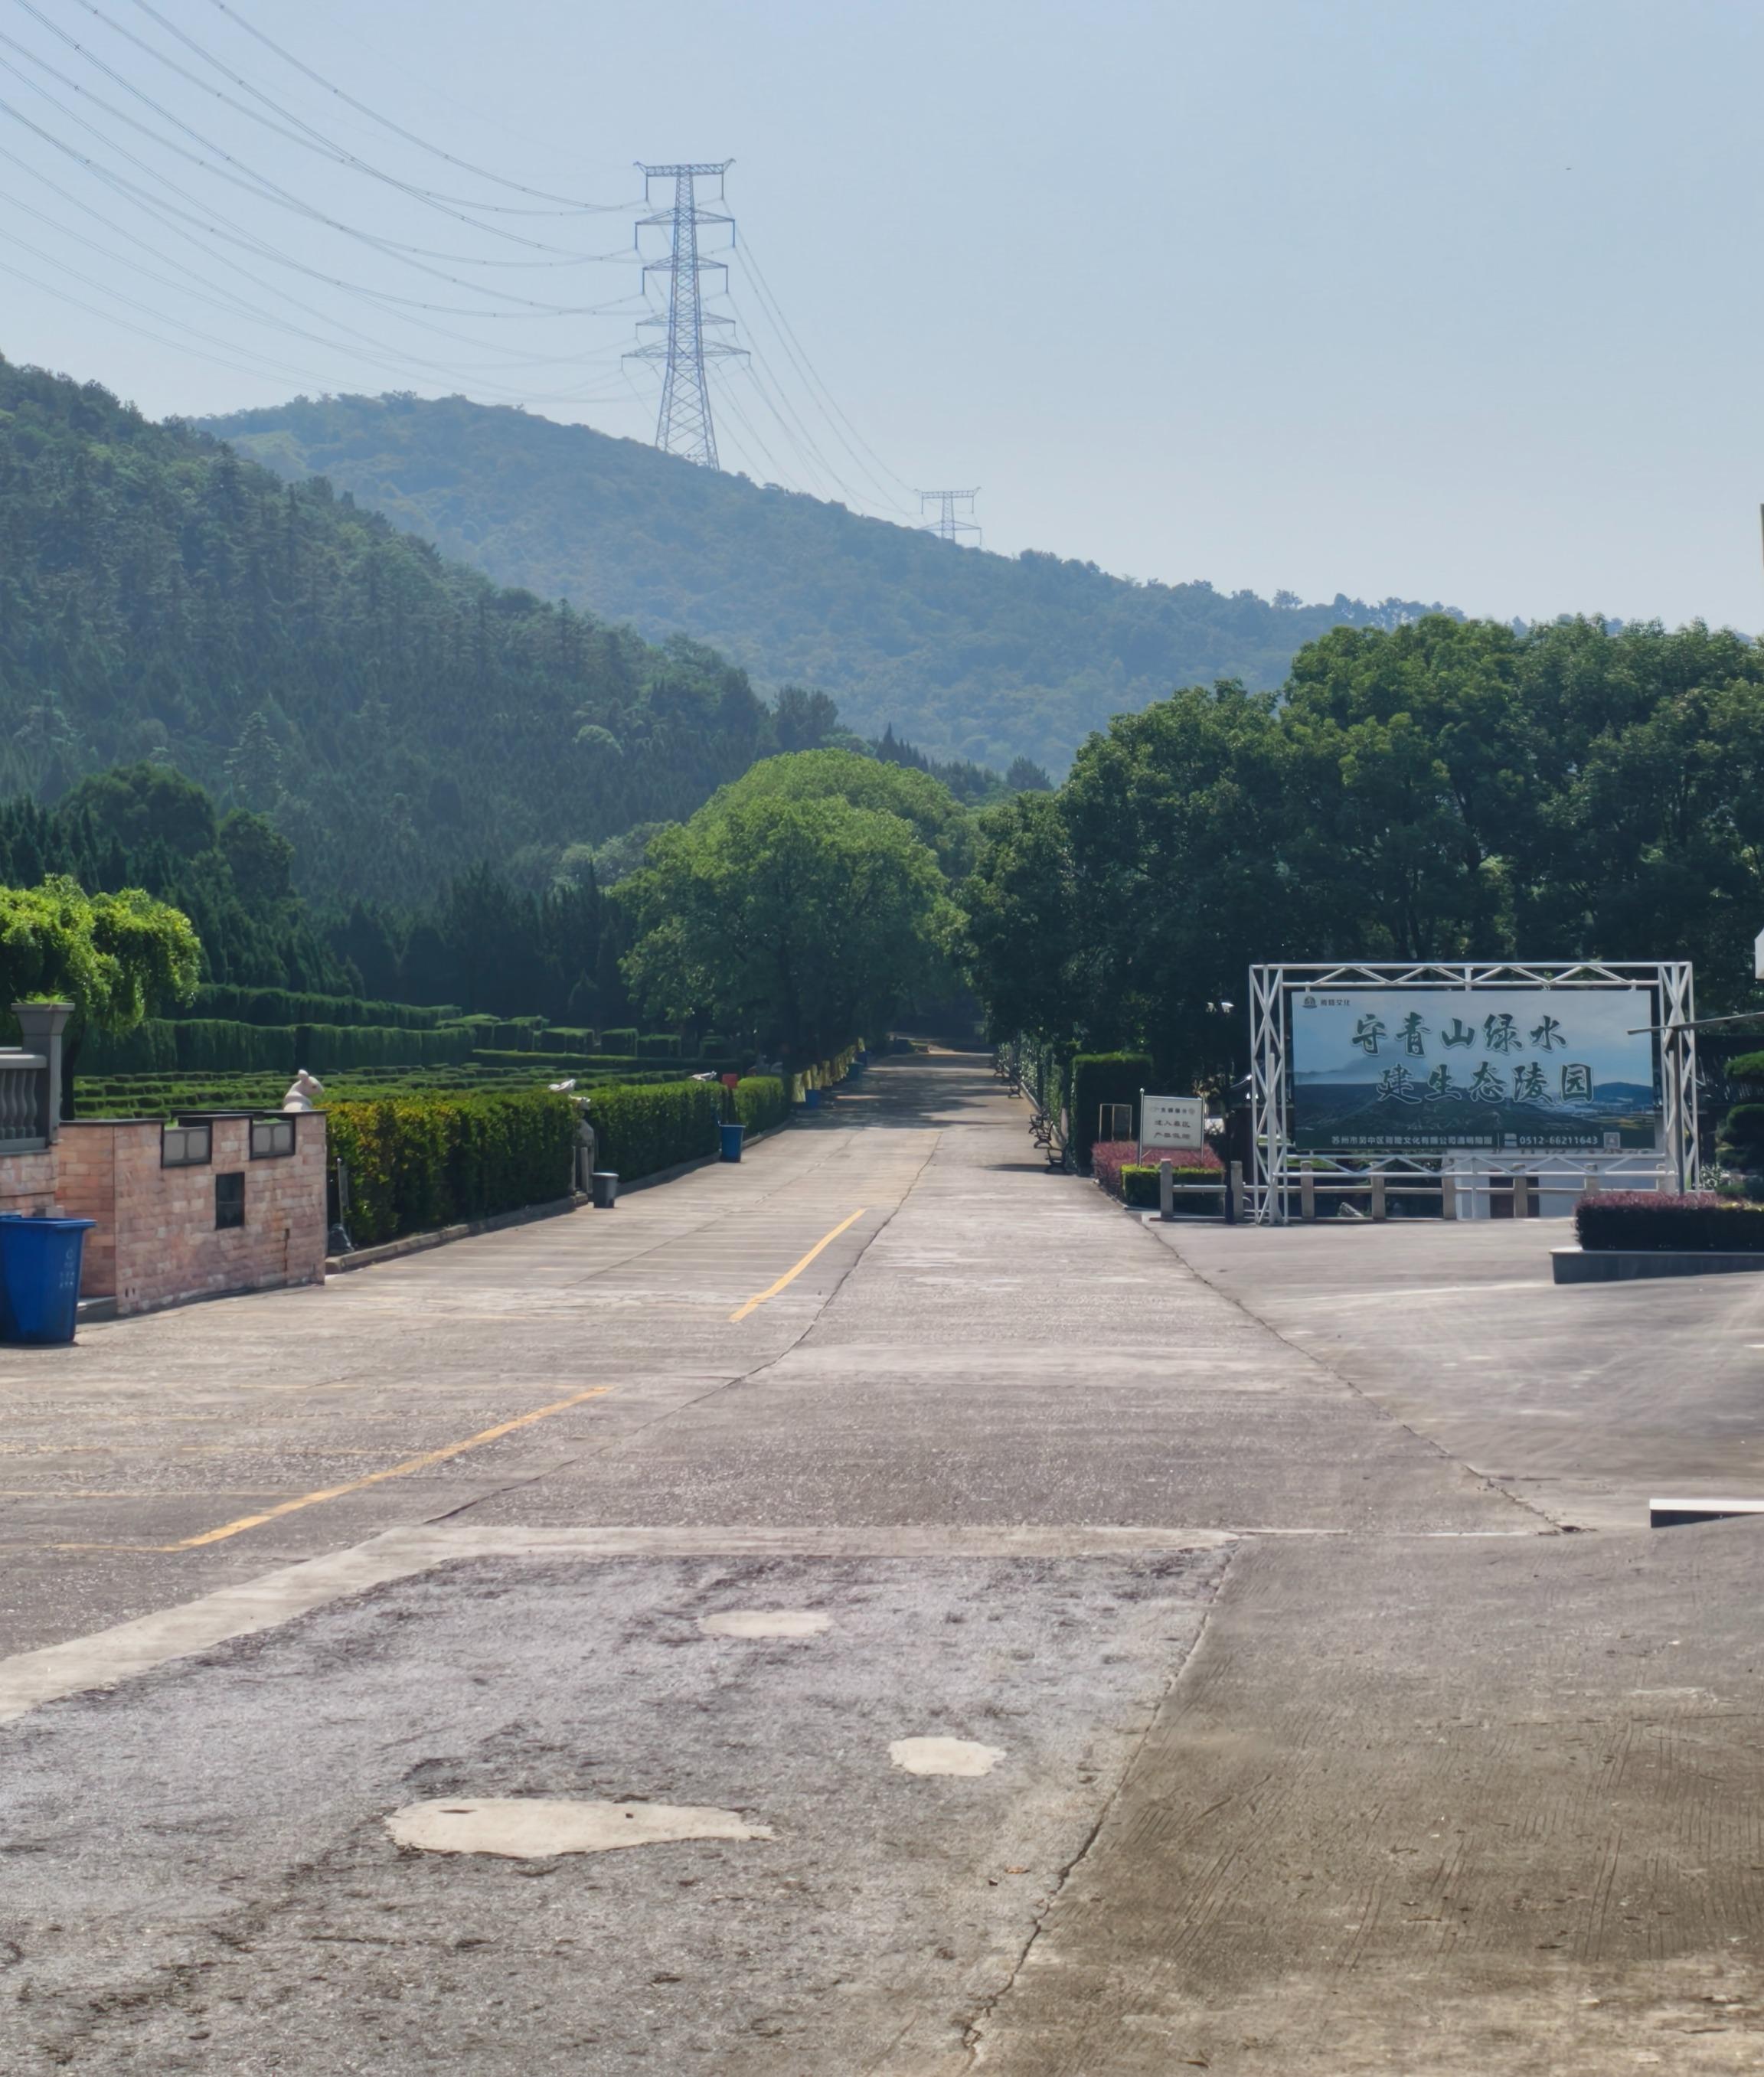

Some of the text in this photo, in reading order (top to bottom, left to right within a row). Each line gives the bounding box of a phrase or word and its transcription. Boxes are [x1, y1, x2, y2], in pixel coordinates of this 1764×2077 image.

[1351, 1011, 1567, 1056] 守青山绿水
[1376, 1061, 1594, 1105] 建生态陵园
[1519, 1135, 1599, 1145] 0512-66211643
